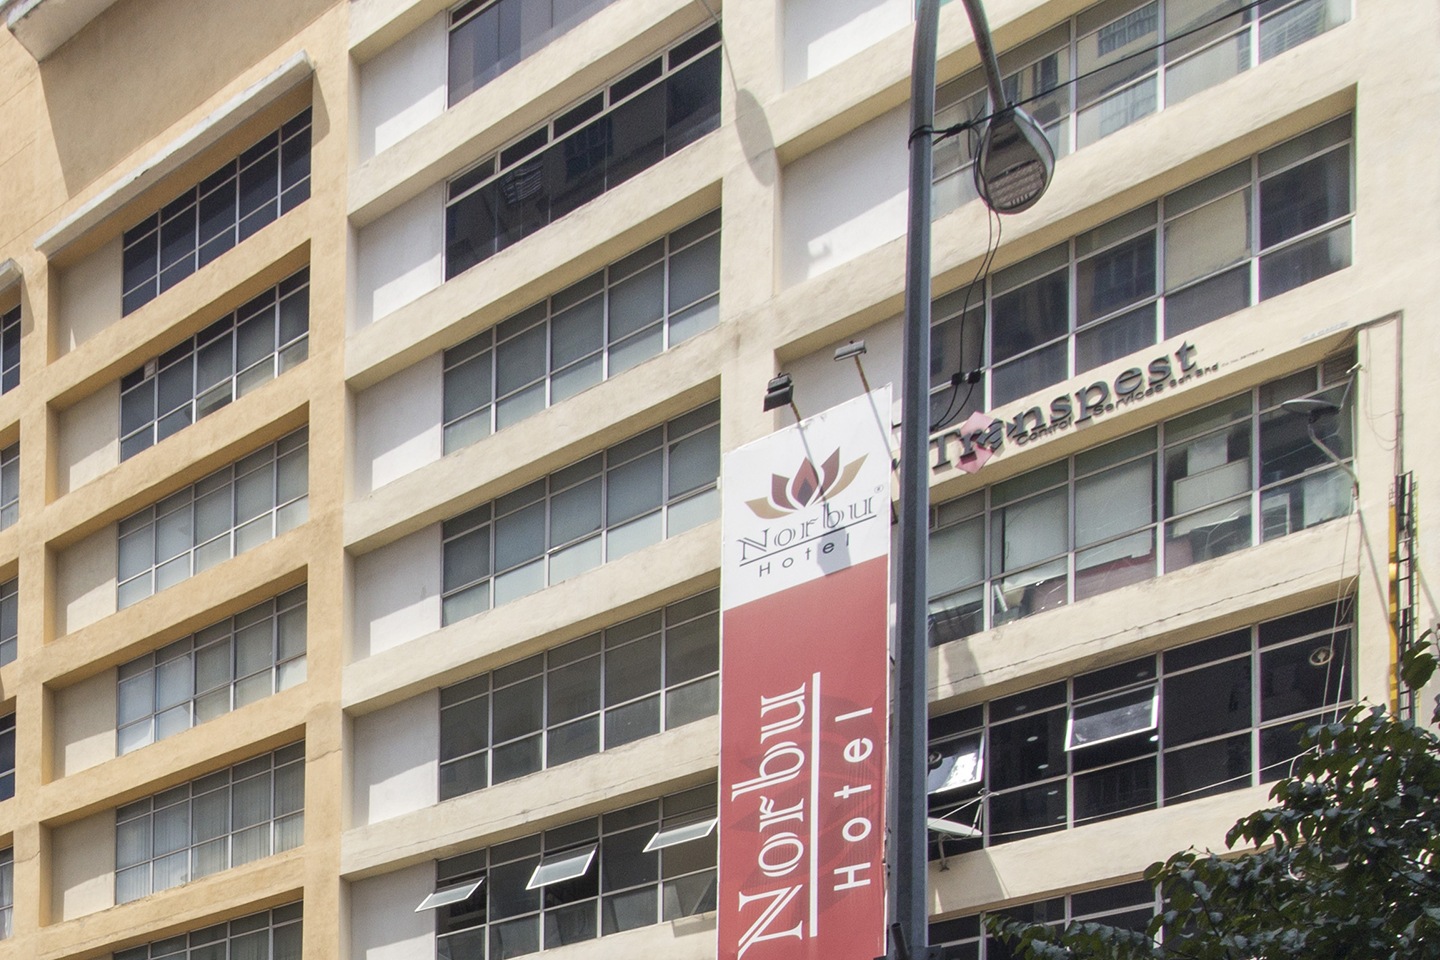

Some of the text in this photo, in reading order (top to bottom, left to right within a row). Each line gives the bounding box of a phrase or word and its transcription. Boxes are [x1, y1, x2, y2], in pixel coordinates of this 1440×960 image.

[930, 340, 1198, 470] Transpest
[1017, 363, 1220, 445] Control Services Sdn Bhd
[736, 496, 874, 562] Norbu
[759, 533, 850, 578] Hotel
[731, 682, 807, 960] Norbu
[833, 708, 874, 891] Hotel
